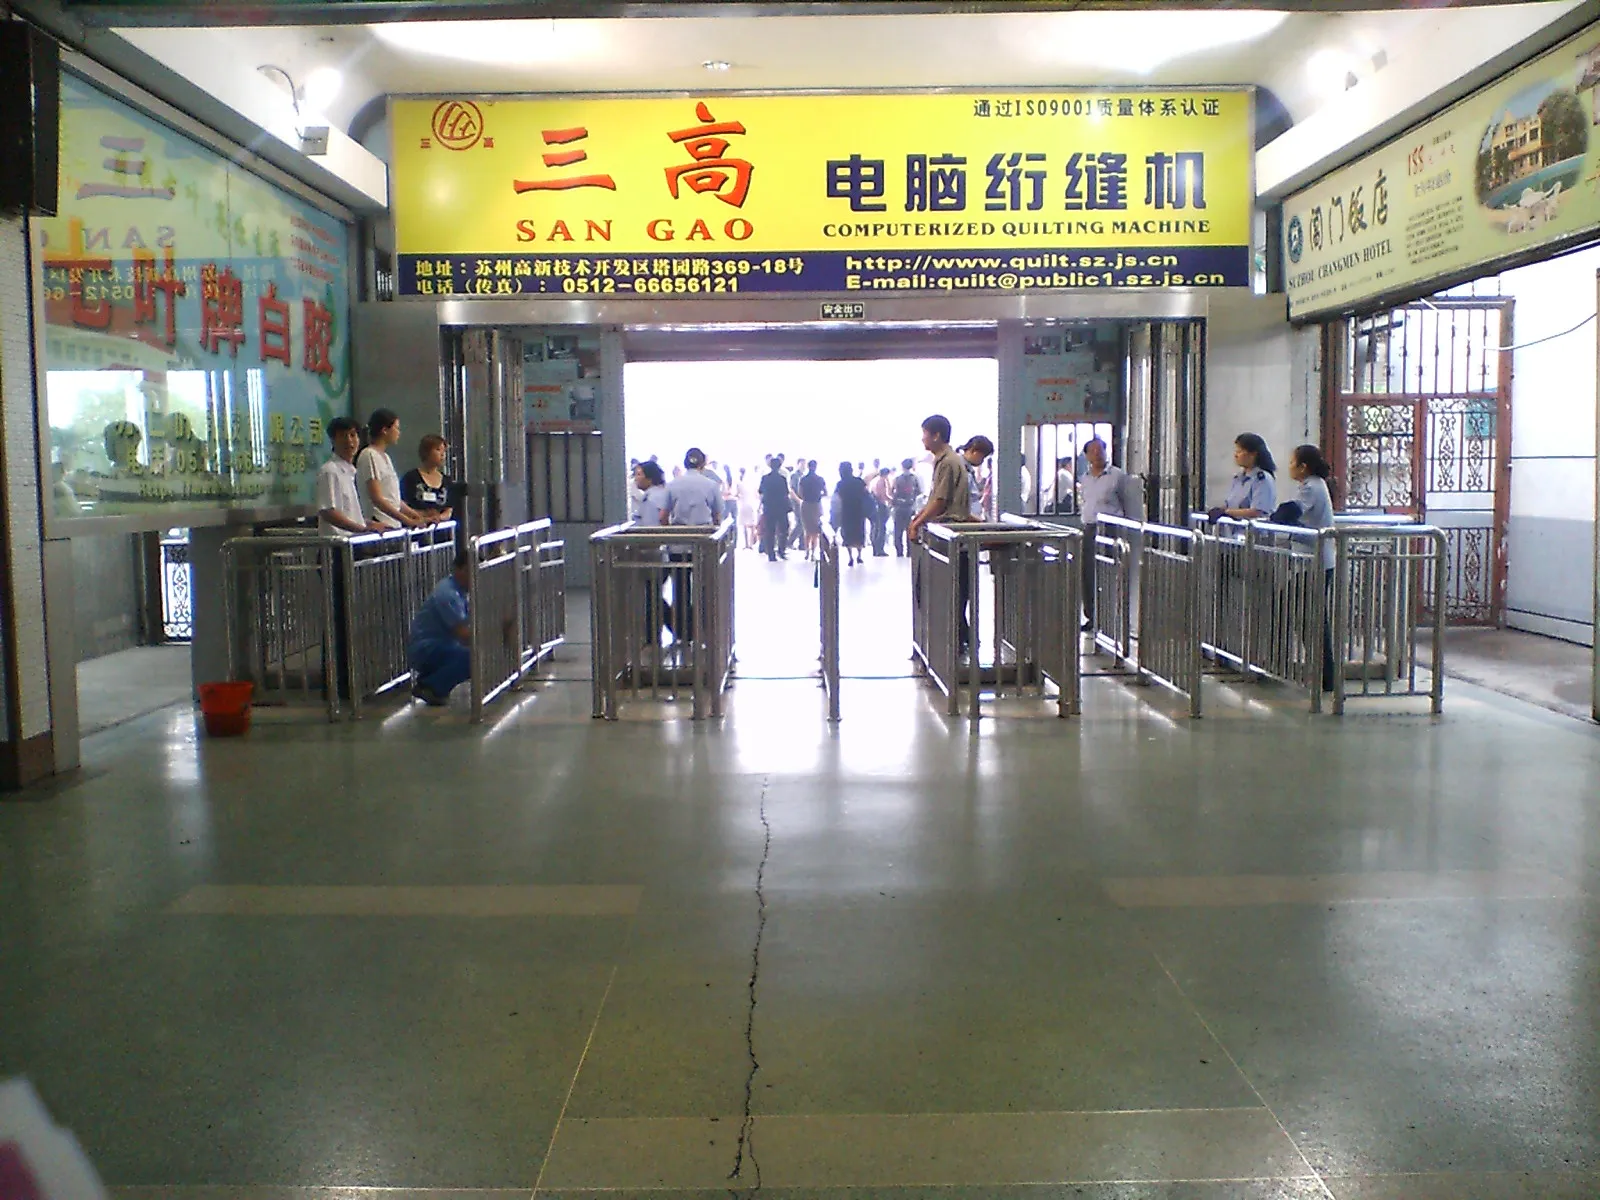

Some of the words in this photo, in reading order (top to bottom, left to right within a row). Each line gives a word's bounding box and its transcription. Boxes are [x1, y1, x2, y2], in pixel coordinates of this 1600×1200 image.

[826, 152, 1207, 212] 电脑绗缝机
[516, 218, 612, 243] SAN
[646, 217, 755, 242] GAO
[823, 222, 995, 238] COMPUTERIZED
[1002, 220, 1104, 237] QUILTING
[1111, 218, 1211, 235] MACHINE
[1363, 238, 1393, 263] HOTEL
[846, 251, 1179, 272] http://www.quilt.sz.js.cn
[846, 270, 1226, 291] E-mail:quilt@public1.sz.js.cn
[823, 303, 863, 314] 安全出口
